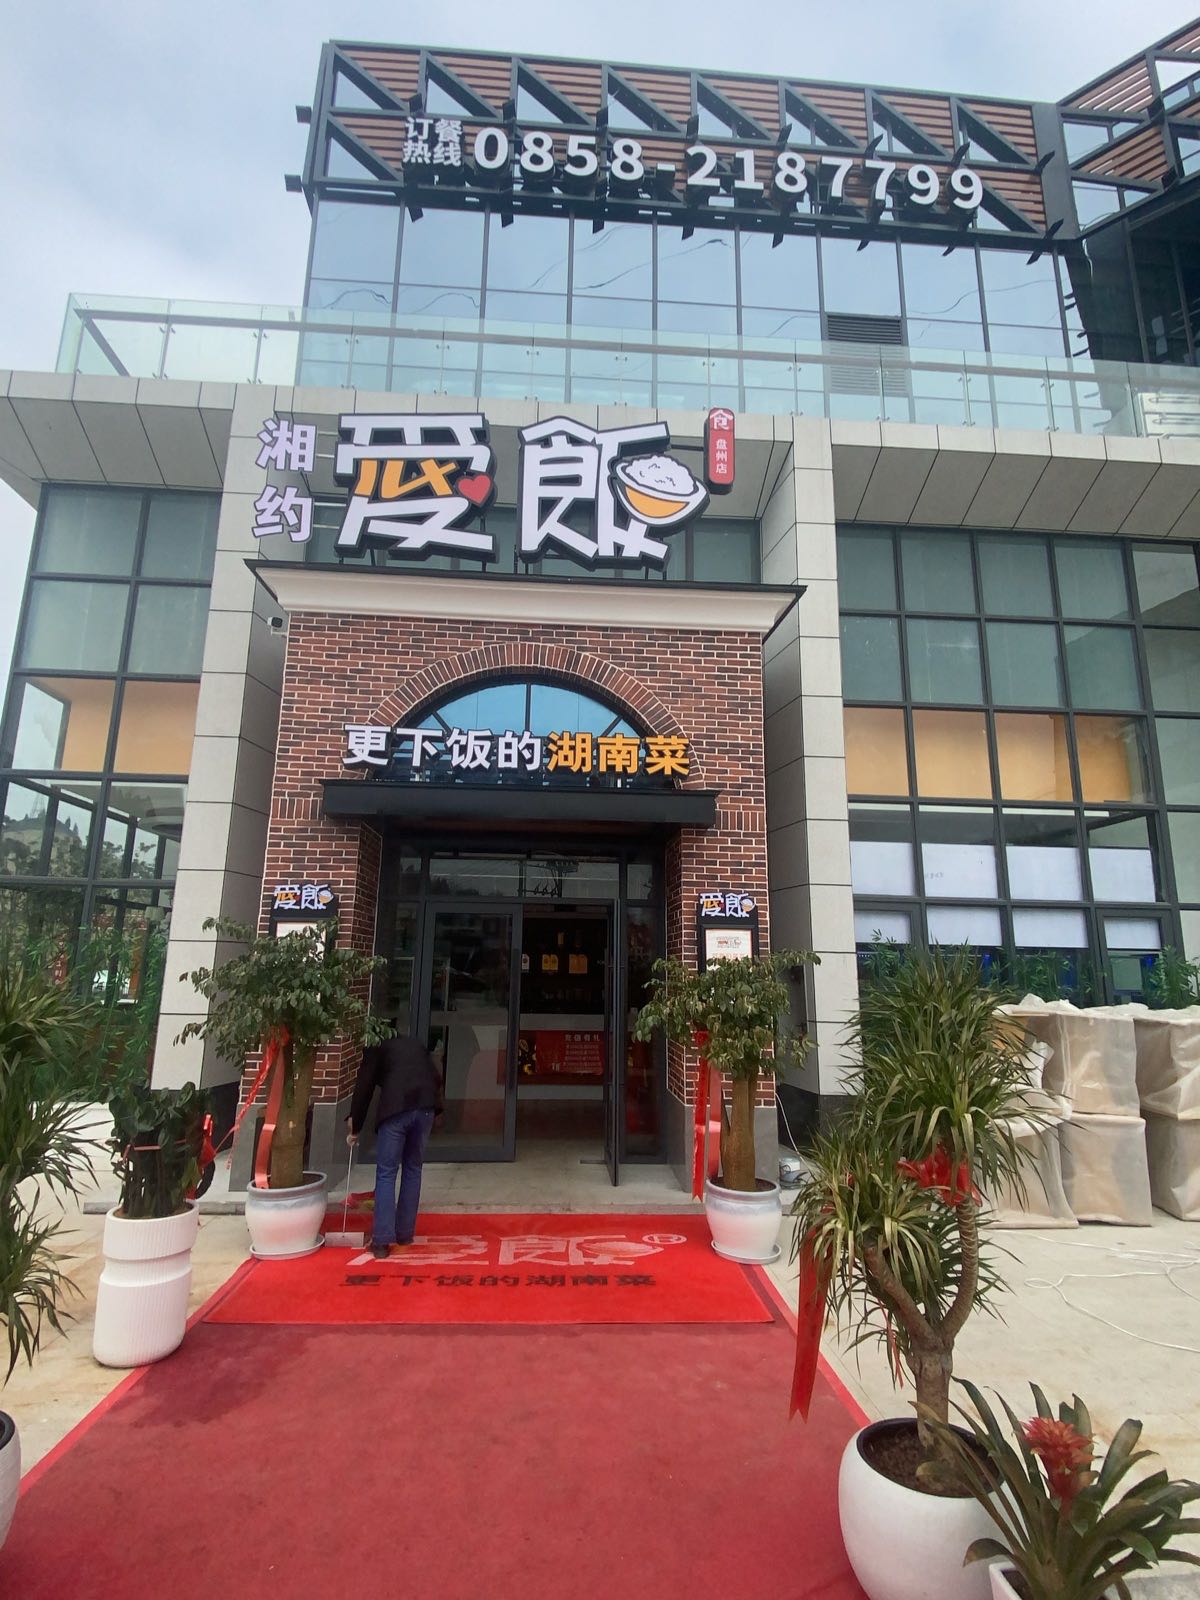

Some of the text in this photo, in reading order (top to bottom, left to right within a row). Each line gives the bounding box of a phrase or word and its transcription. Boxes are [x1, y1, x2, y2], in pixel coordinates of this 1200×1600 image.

[404, 117, 463, 143] 订餐
[402, 140, 462, 167] 热线
[473, 126, 984, 210] 0858-2187799
[715, 438, 728, 474] 盘州店
[251, 418, 318, 543] 湘约
[342, 723, 692, 776] 更下饭的湖南菜
[338, 1273, 657, 1288] 更下饭的湖南菜
